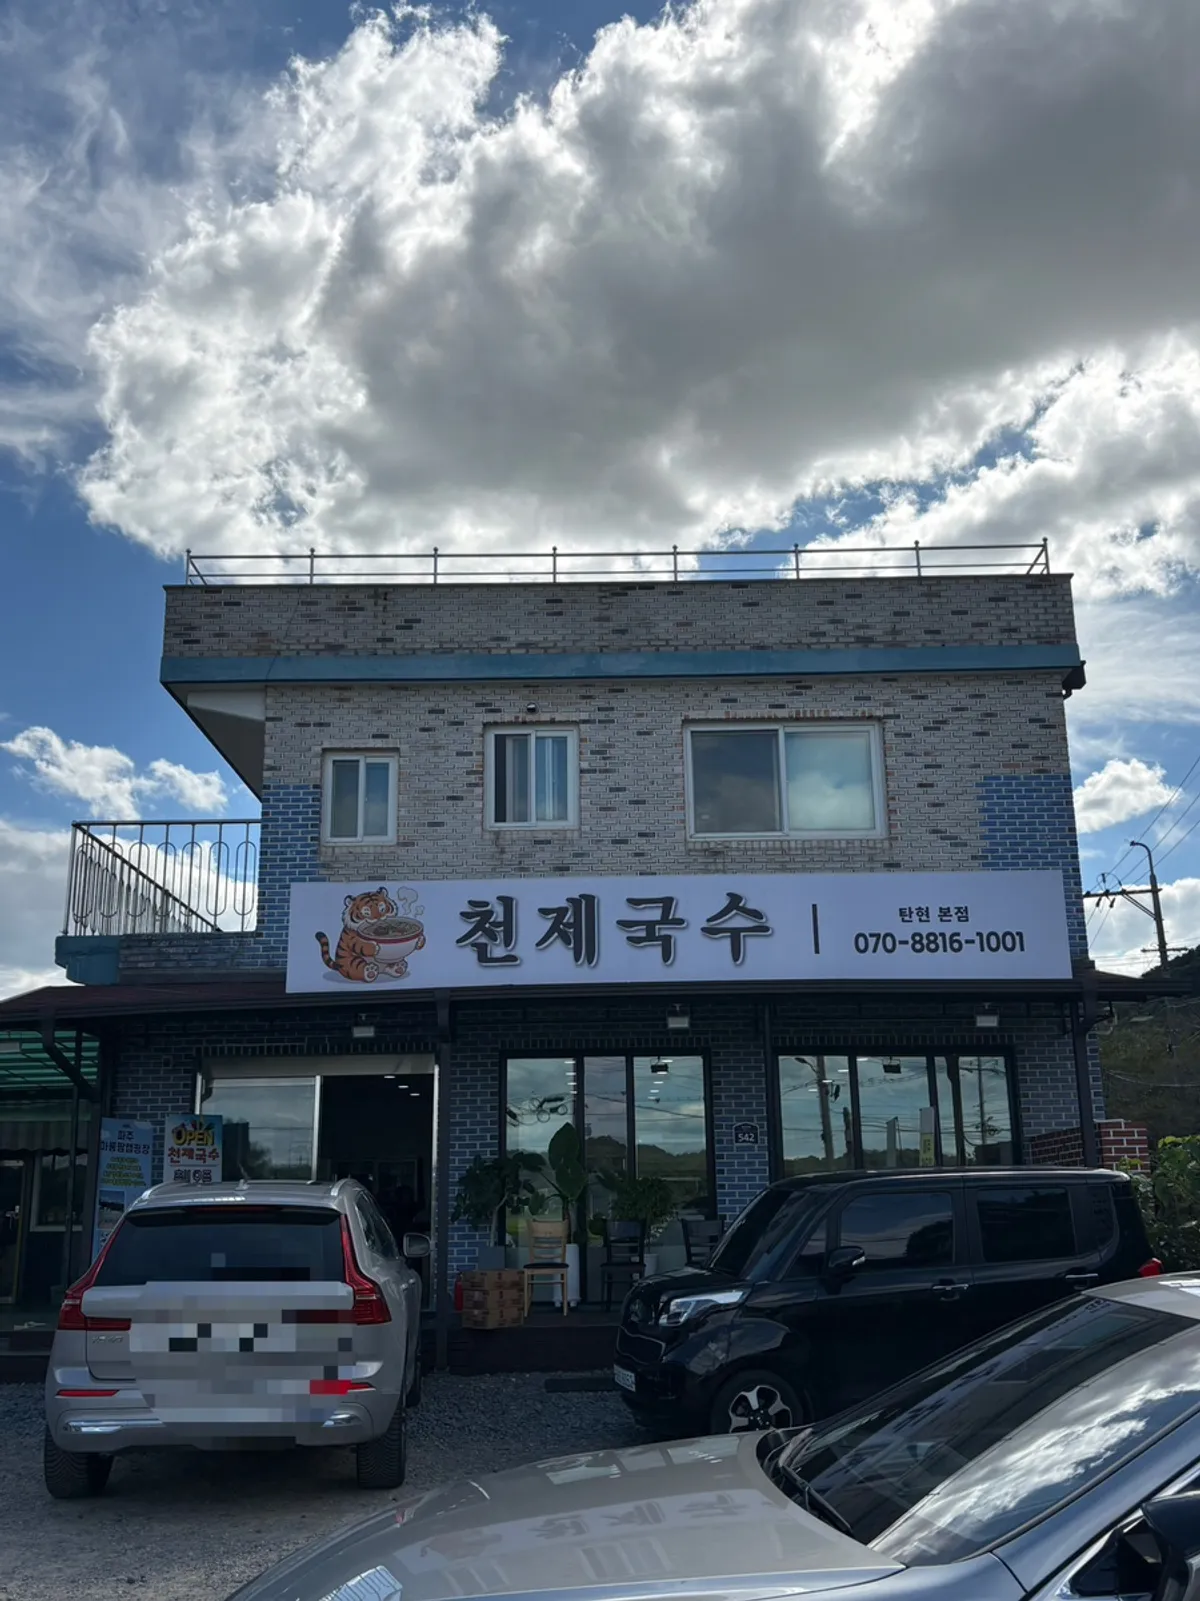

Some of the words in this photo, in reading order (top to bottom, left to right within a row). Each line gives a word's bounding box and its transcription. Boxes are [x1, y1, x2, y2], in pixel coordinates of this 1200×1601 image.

[898, 906, 931, 923] 탄현
[937, 905, 970, 922] 본점
[455, 892, 773, 966] 천제국수
[854, 931, 1025, 953] 070-8816-1001
[173, 1128, 214, 1146] OPEN
[738, 1133, 755, 1142] 542
